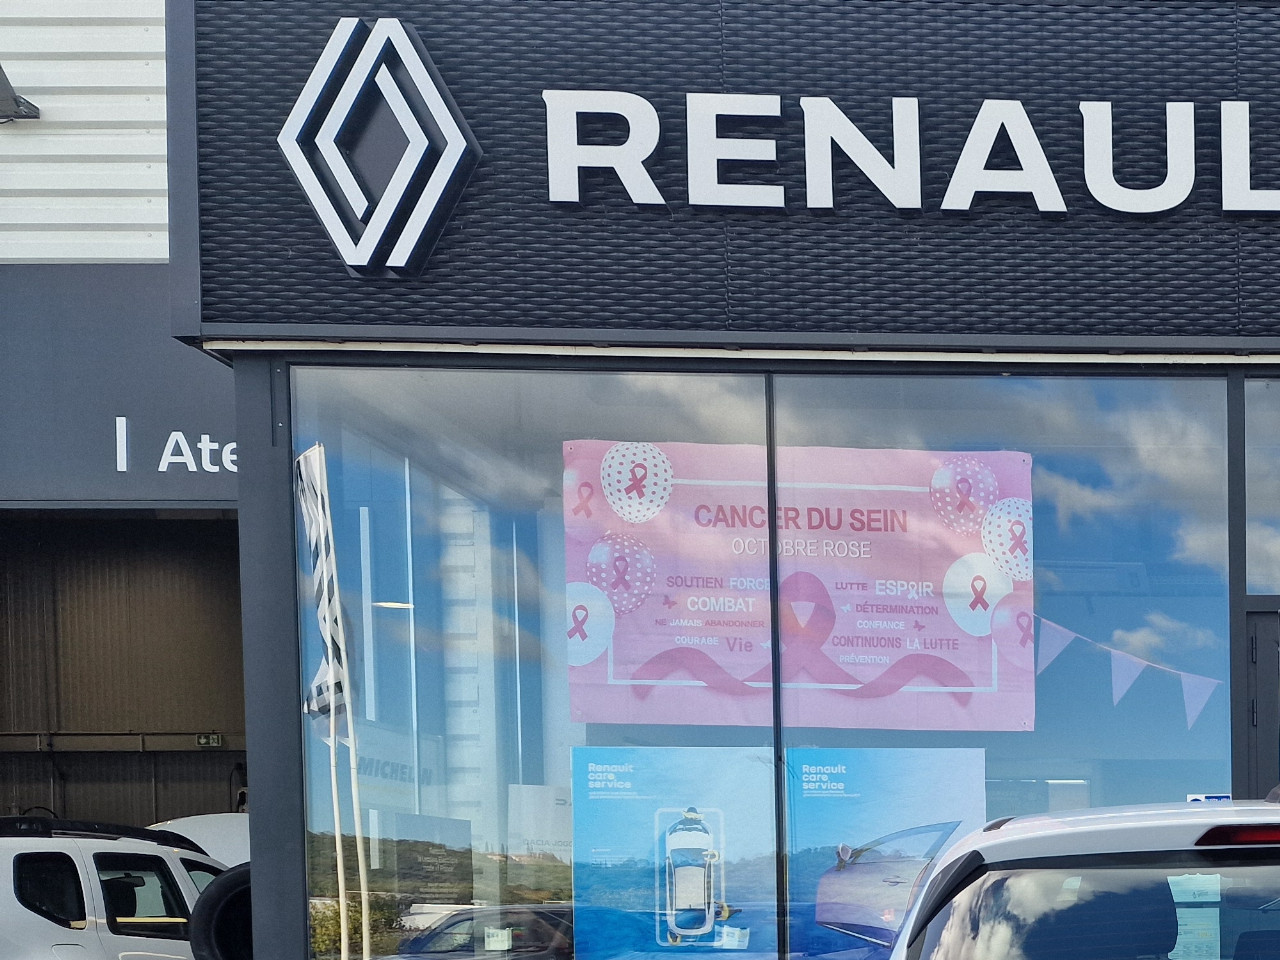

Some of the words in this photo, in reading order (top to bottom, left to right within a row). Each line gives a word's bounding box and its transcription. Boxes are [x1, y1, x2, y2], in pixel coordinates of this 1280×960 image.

[157, 431, 238, 473] Ate
[694, 504, 801, 530] CANCER
[806, 507, 843, 530] DU
[849, 508, 908, 532] SEIN
[822, 540, 872, 558] ROSE
[666, 575, 724, 589] SOUTIEN
[729, 577, 770, 590] FORCE
[835, 581, 868, 591] LUTTE
[687, 596, 756, 612] COMBAT
[855, 601, 938, 615] DÉTERMINATION
[655, 618, 667, 626] NE
[669, 618, 702, 627] JAMAIS
[704, 619, 765, 628] ABANDONNER
[857, 620, 905, 629] CONFIANCE
[675, 635, 719, 645] COURAGE
[726, 637, 753, 652] Vie
[832, 635, 902, 648] CONTINUONS
[906, 637, 920, 650] LA
[923, 638, 959, 650] LUTTE
[839, 653, 890, 663] PRÉVENTION
[357, 755, 433, 786] MICHELN
[588, 762, 634, 772] Renault
[802, 764, 847, 773] Renault
[588, 772, 615, 780] care
[802, 773, 829, 781] care
[588, 780, 632, 789] service
[802, 780, 845, 789] service
